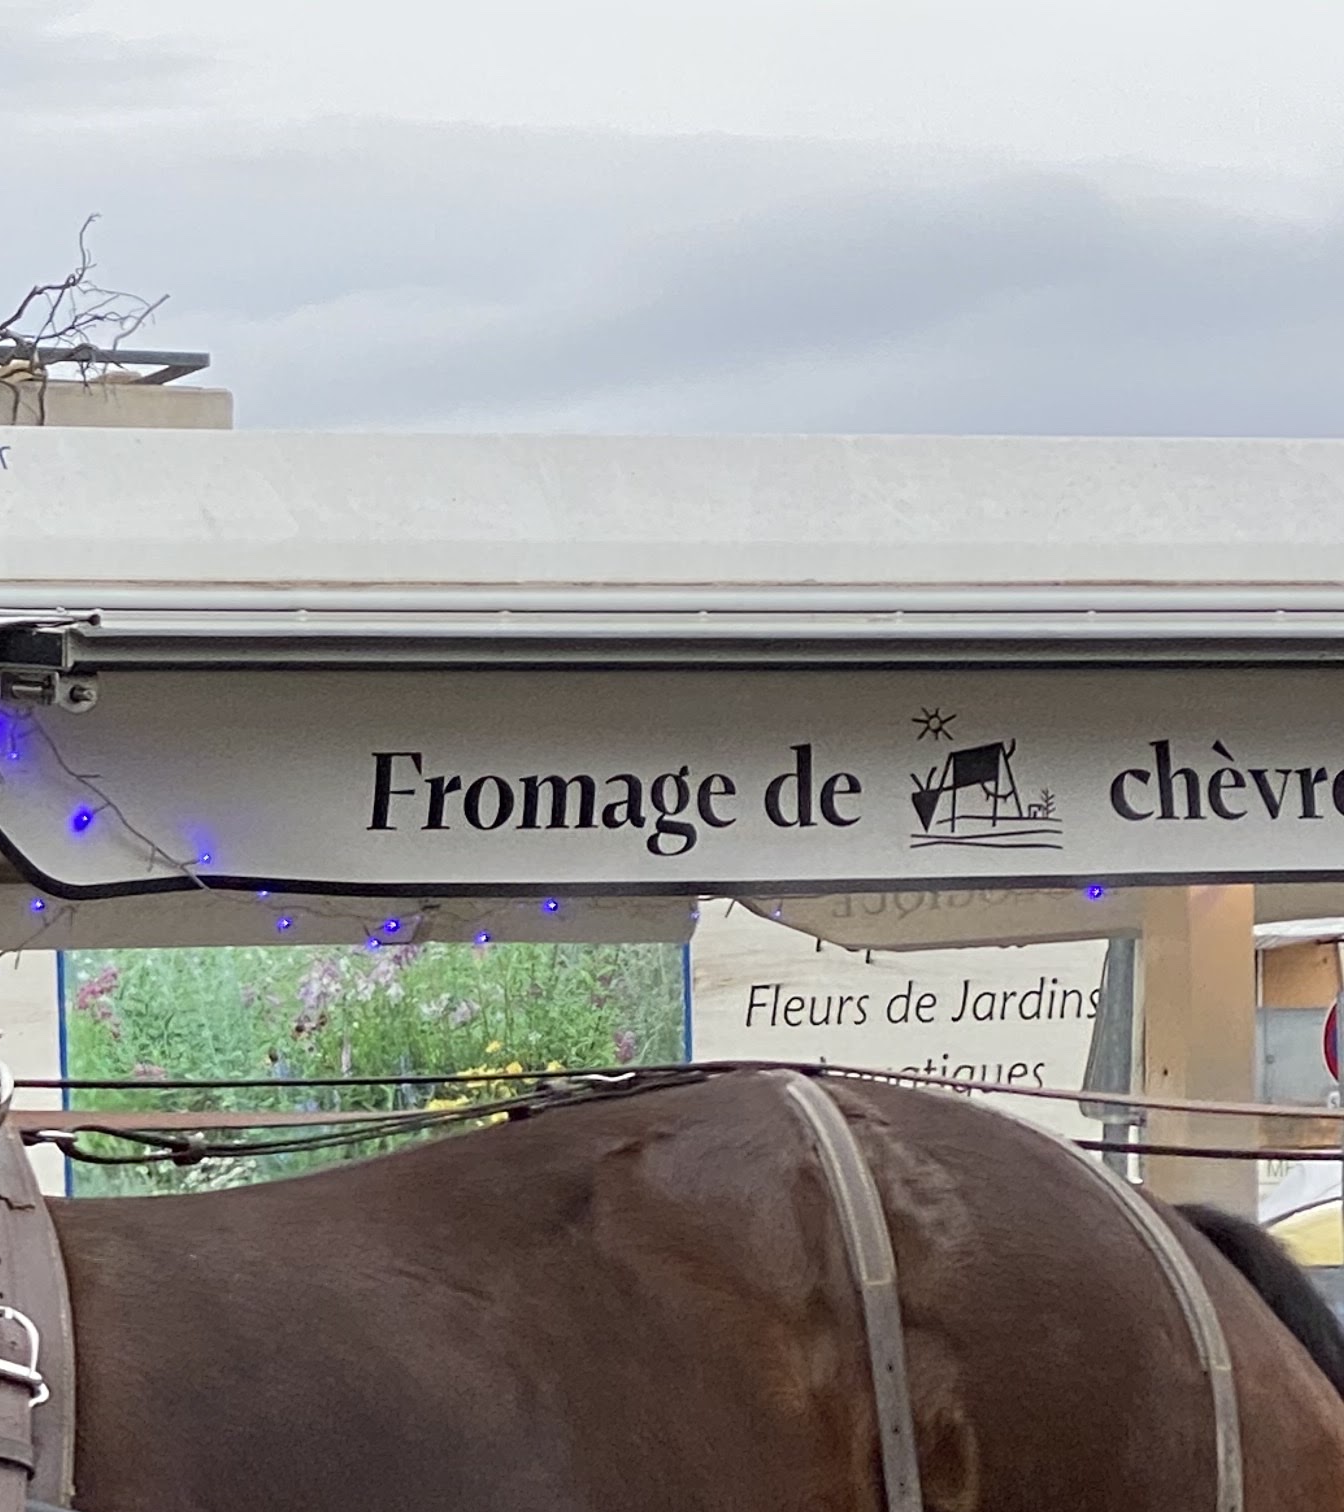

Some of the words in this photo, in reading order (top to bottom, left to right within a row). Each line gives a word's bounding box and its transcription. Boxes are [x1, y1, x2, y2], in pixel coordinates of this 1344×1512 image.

[365, 749, 738, 857] Fromage
[763, 743, 862, 829] de
[1108, 738, 1344, 823] chèvr
[744, 983, 870, 1029] Fleurs
[885, 980, 938, 1024] de
[950, 976, 1102, 1023] Jardins
